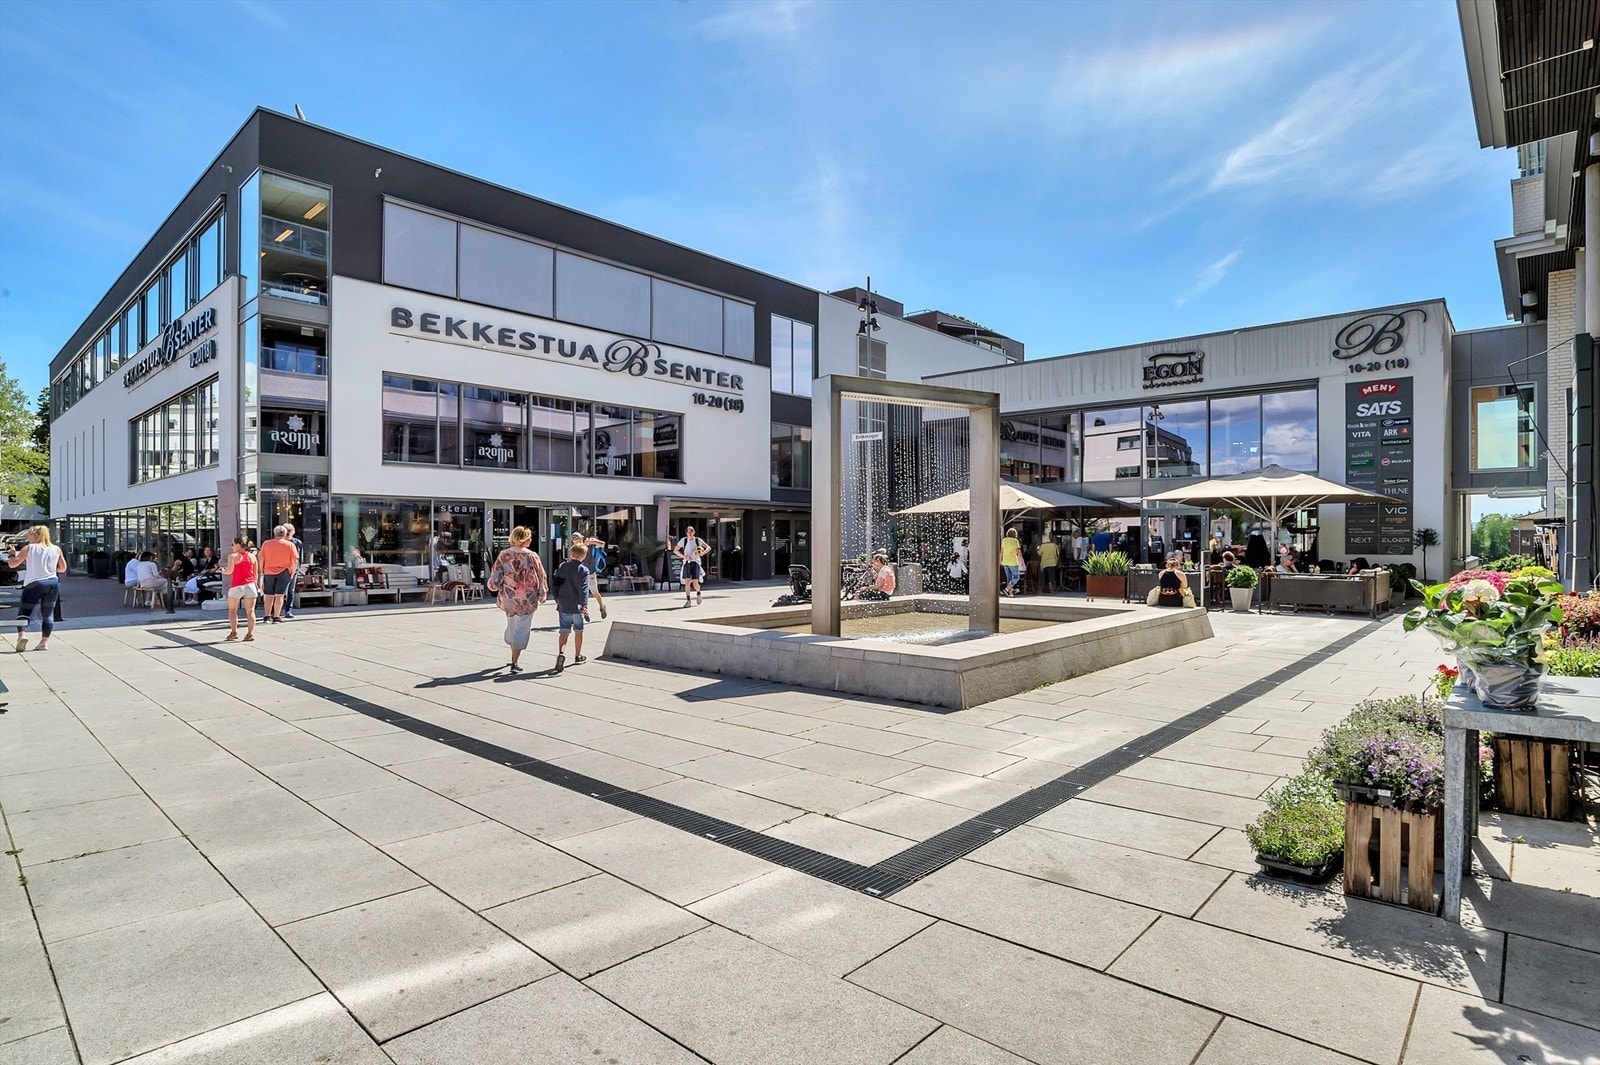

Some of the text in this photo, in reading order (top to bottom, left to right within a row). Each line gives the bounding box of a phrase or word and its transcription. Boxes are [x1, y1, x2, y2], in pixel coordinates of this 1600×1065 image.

[174, 307, 216, 352] SENTER
[391, 306, 599, 363] BEKKESTUA
[654, 358, 745, 391] SENTER
[1142, 359, 1204, 381] EGON
[1348, 357, 1410, 374] 10-20 (18)
[1362, 384, 1396, 395] MENY
[1356, 400, 1402, 417] SATS
[270, 430, 320, 450] aroma
[1383, 428, 1398, 437] ARK
[478, 446, 514, 463] aroma
[1383, 487, 1409, 495] THUNE
[440, 504, 478, 513] steam
[1384, 507, 1408, 515] VIC
